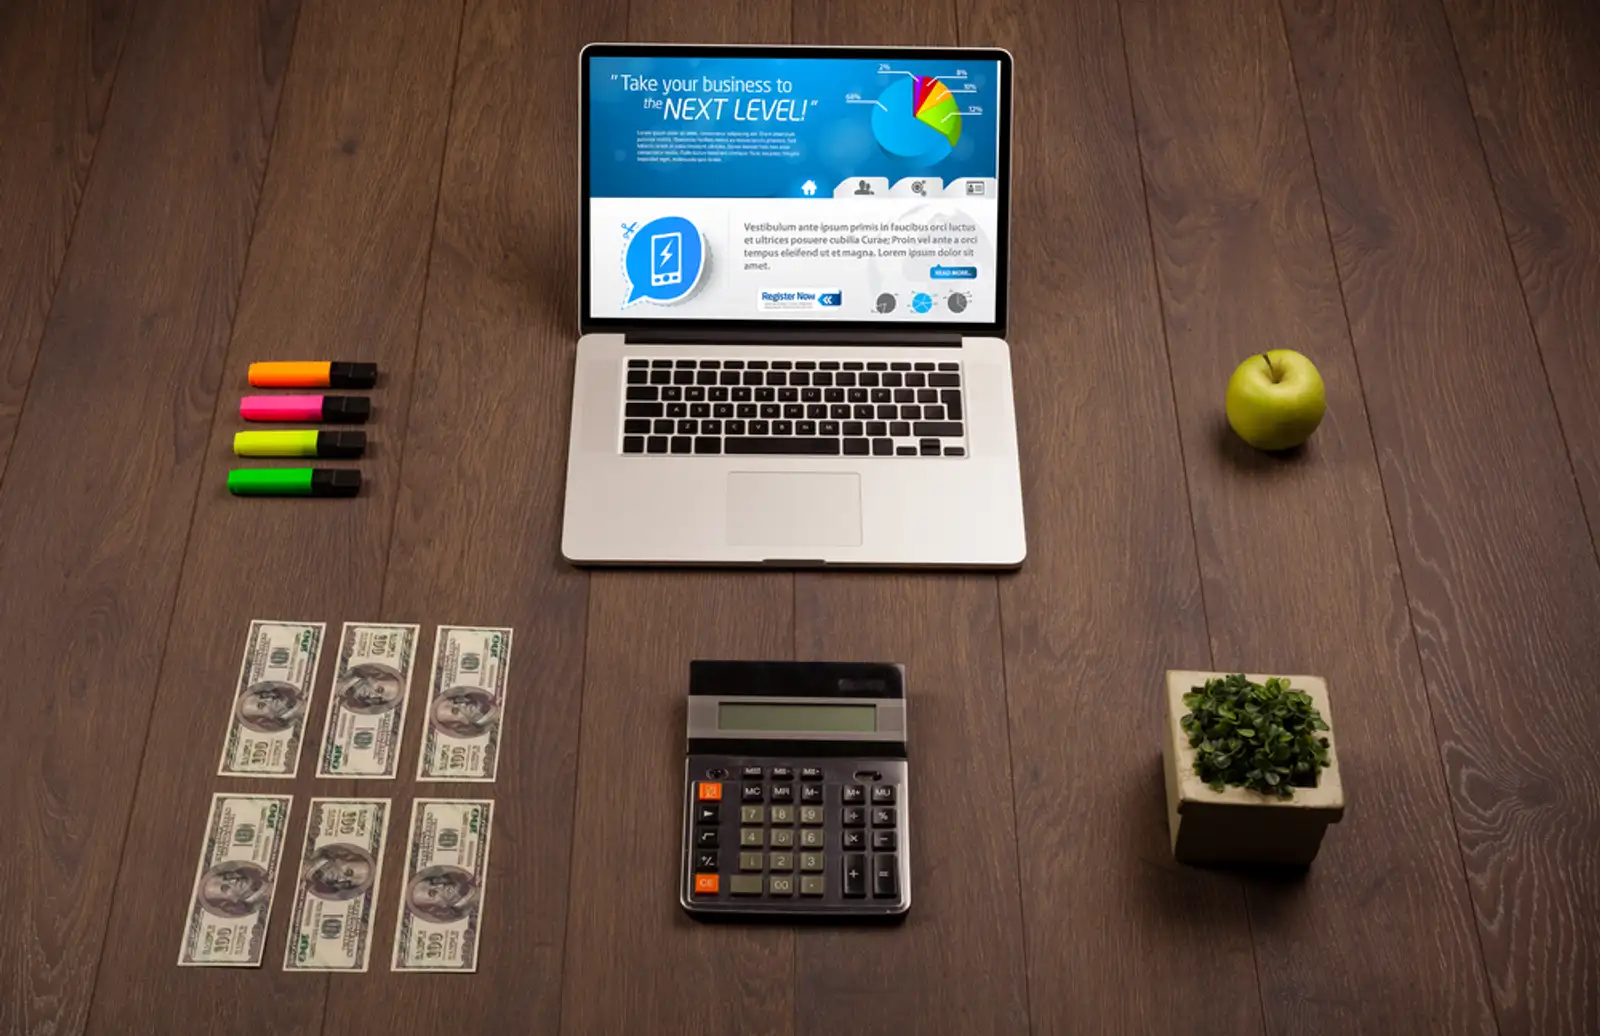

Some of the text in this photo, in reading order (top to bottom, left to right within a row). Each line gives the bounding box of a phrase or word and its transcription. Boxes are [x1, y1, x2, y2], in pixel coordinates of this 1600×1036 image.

[662, 78, 698, 96] your
[703, 76, 772, 93] business
[777, 78, 793, 93] to
[643, 97, 663, 109] the
[663, 98, 729, 121] NEXT
[744, 222, 976, 233] Vestibulum ante ipsum primis in faucibus orci luctus
[744, 236, 754, 244] et
[756, 235, 789, 244] ultrices
[790, 236, 828, 246] posuere
[829, 235, 859, 244] cubilia
[861, 236, 890, 245] Curae;
[892, 236, 916, 244] Proin
[917, 236, 931, 244] vel
[960, 236, 978, 244] orci
[744, 248, 974, 259] tempus eleifend ut et magna. Lorem ipsum dolor sit
[762, 292, 816, 302] Register Now
[372, 634, 388, 655] 100
[252, 741, 268, 764] 100
[450, 747, 465, 769] 100
[750, 810, 756, 818] 7
[779, 809, 785, 819] 8
[808, 810, 815, 819] 9
[340, 811, 356, 834] 100
[748, 833, 755, 841] 4
[779, 834, 785, 842] 5
[808, 834, 815, 842] 6
[778, 857, 785, 866] 2
[808, 857, 815, 866] 3
[775, 881, 788, 889] 00
[214, 928, 231, 953] 100
[426, 933, 443, 958] 100
